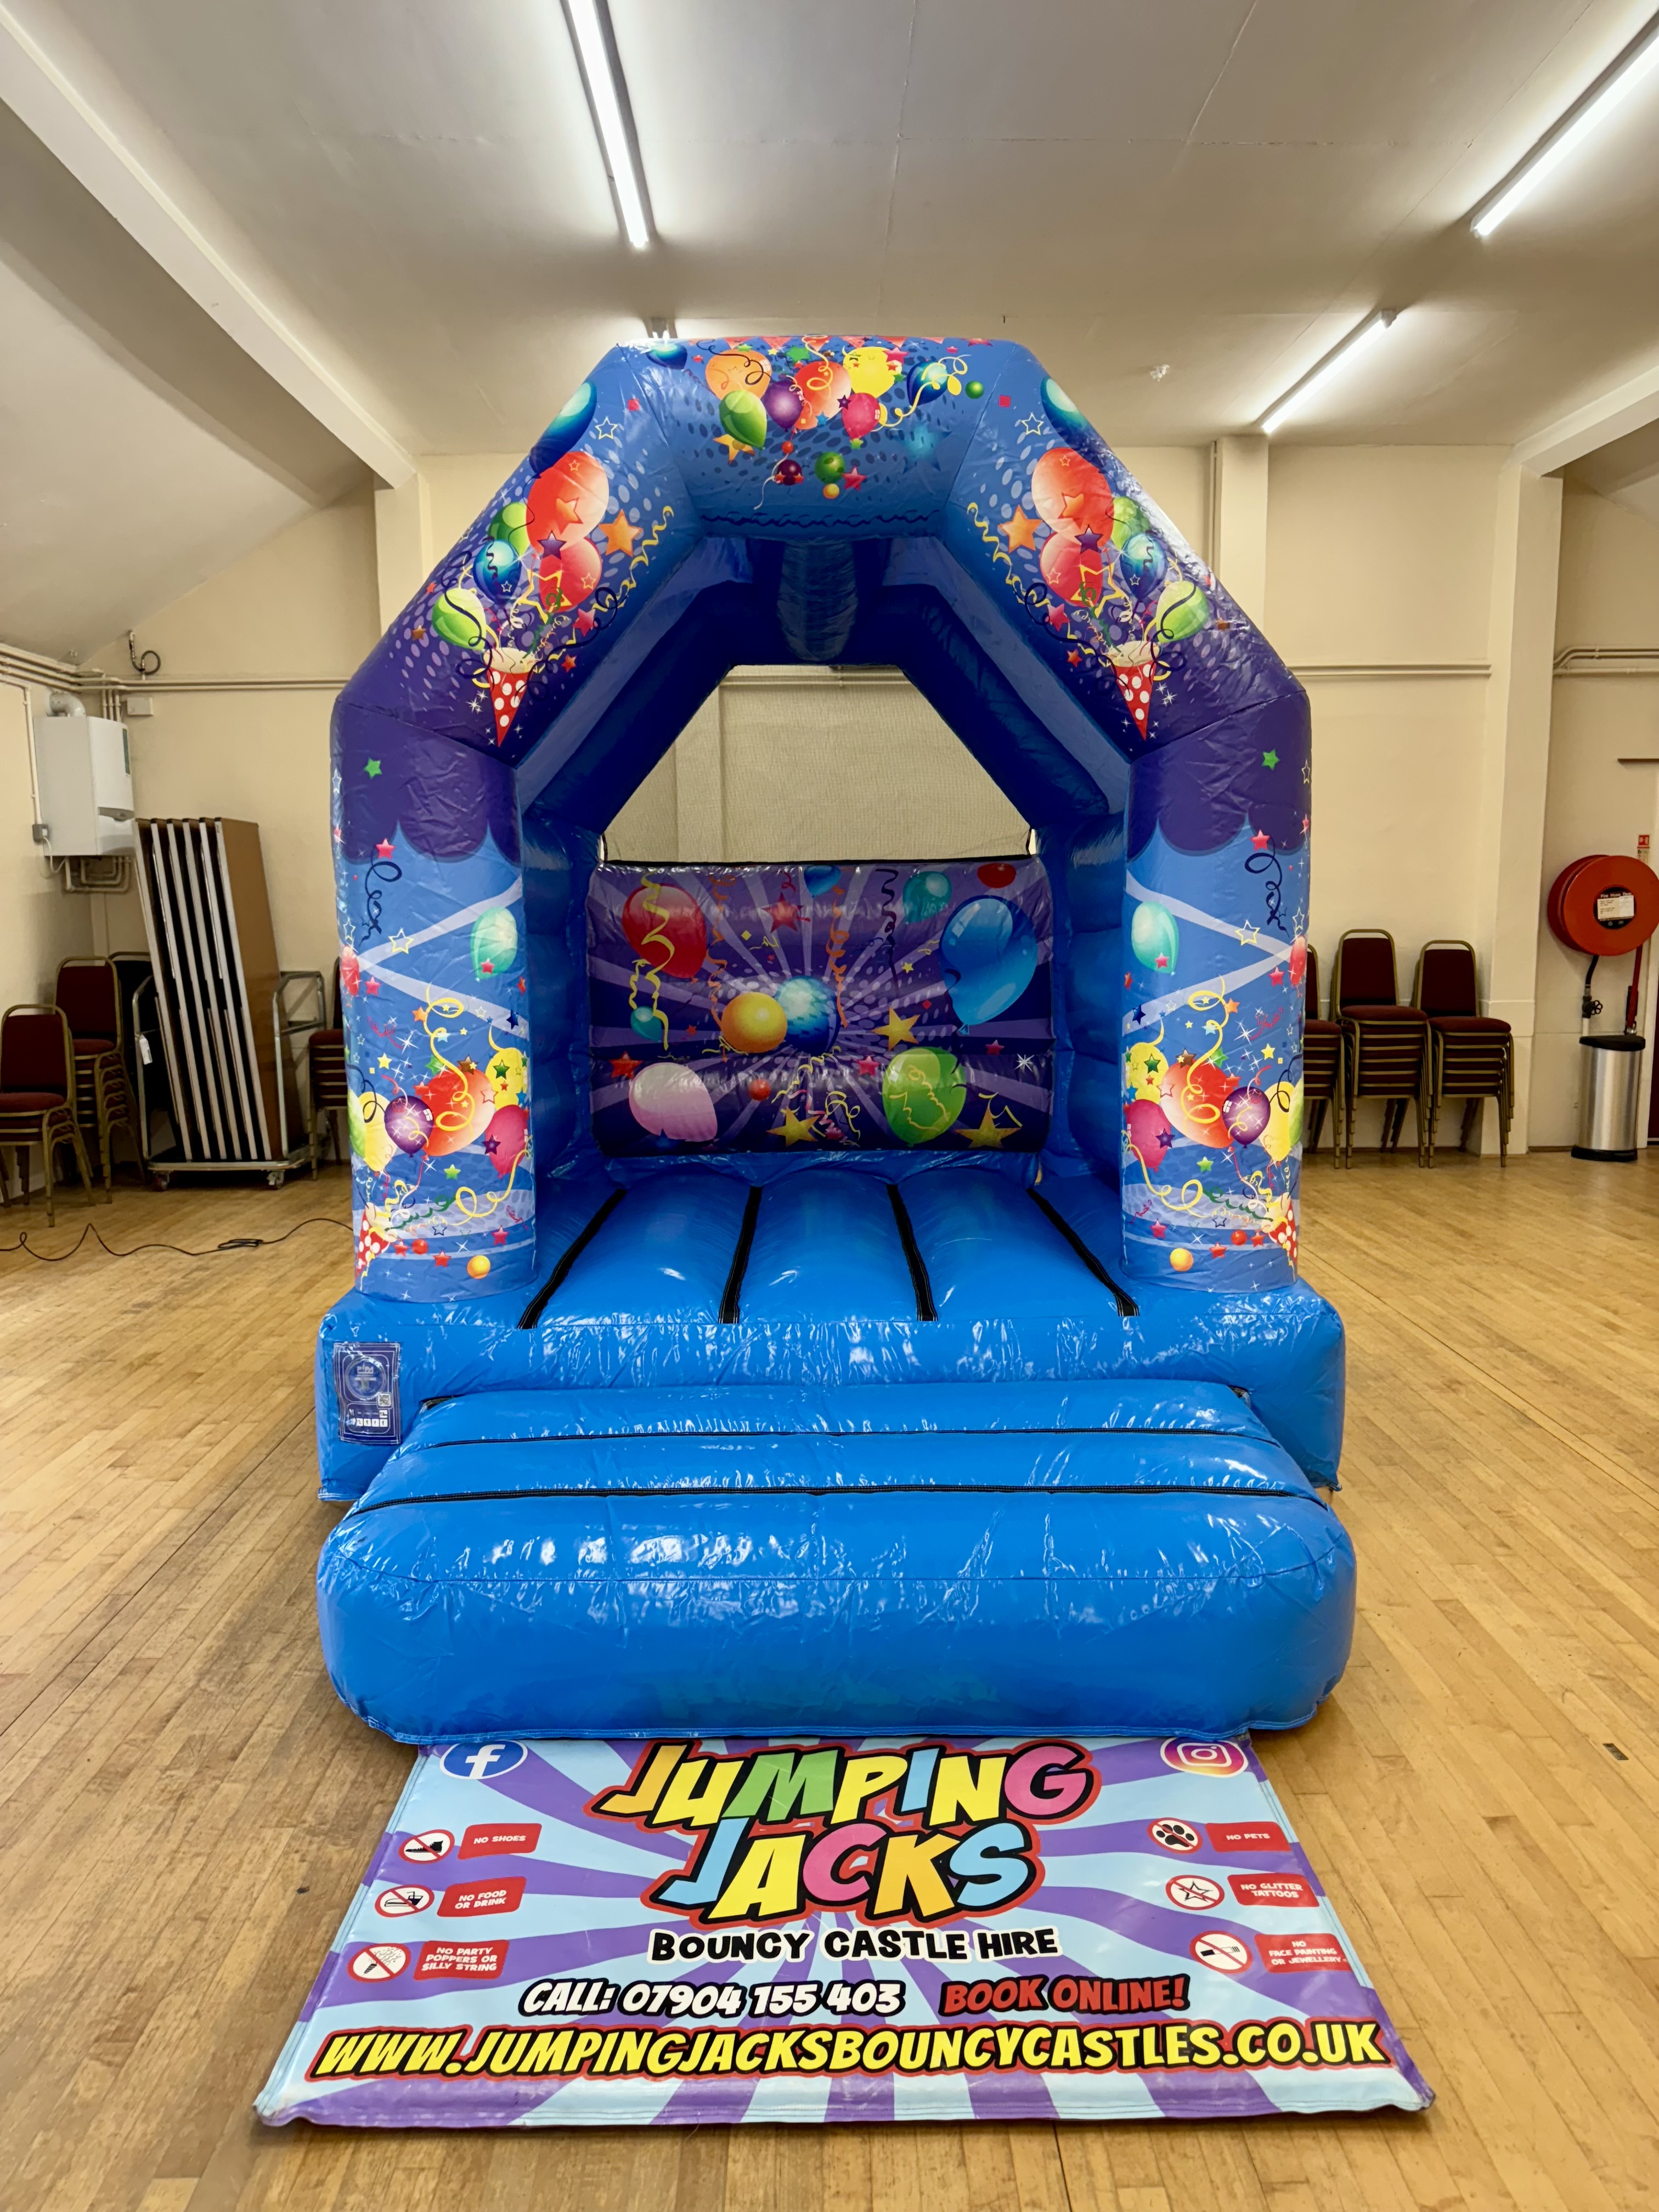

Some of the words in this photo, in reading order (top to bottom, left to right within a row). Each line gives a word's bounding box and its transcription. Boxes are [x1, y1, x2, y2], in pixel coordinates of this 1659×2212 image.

[597, 1742, 1088, 1827] JUMPING
[473, 1836, 489, 1844] NO
[656, 1815, 1030, 1920] JACKS
[1260, 1883, 1303, 1891] GLITTER
[459, 1894, 475, 1902] NO
[477, 1889, 507, 1900] FOOD
[1251, 1890, 1299, 1898] TATTOOS
[455, 1901, 470, 1910] OR
[473, 1897, 507, 1908] DRINK
[652, 1931, 810, 1960] BOUNCY
[826, 1929, 966, 1960] CASTLE
[978, 1927, 1058, 1958] HIRE
[456, 1947, 493, 1955] PARTY
[425, 1954, 478, 1963] POPPERS
[421, 1962, 453, 1971] SILLY
[455, 1963, 497, 1971] STRING
[524, 1982, 612, 2012] CALL:
[622, 1985, 742, 2016] 07904
[753, 1984, 820, 2015] 155
[826, 1983, 902, 2013] 403
[946, 1978, 1047, 2012] BOOK
[1053, 1977, 1185, 2012] ONLINE!
[315, 2021, 1386, 2075] WWW.JUMPINGJACKSBOUNCYCASTLES.CO.UK
